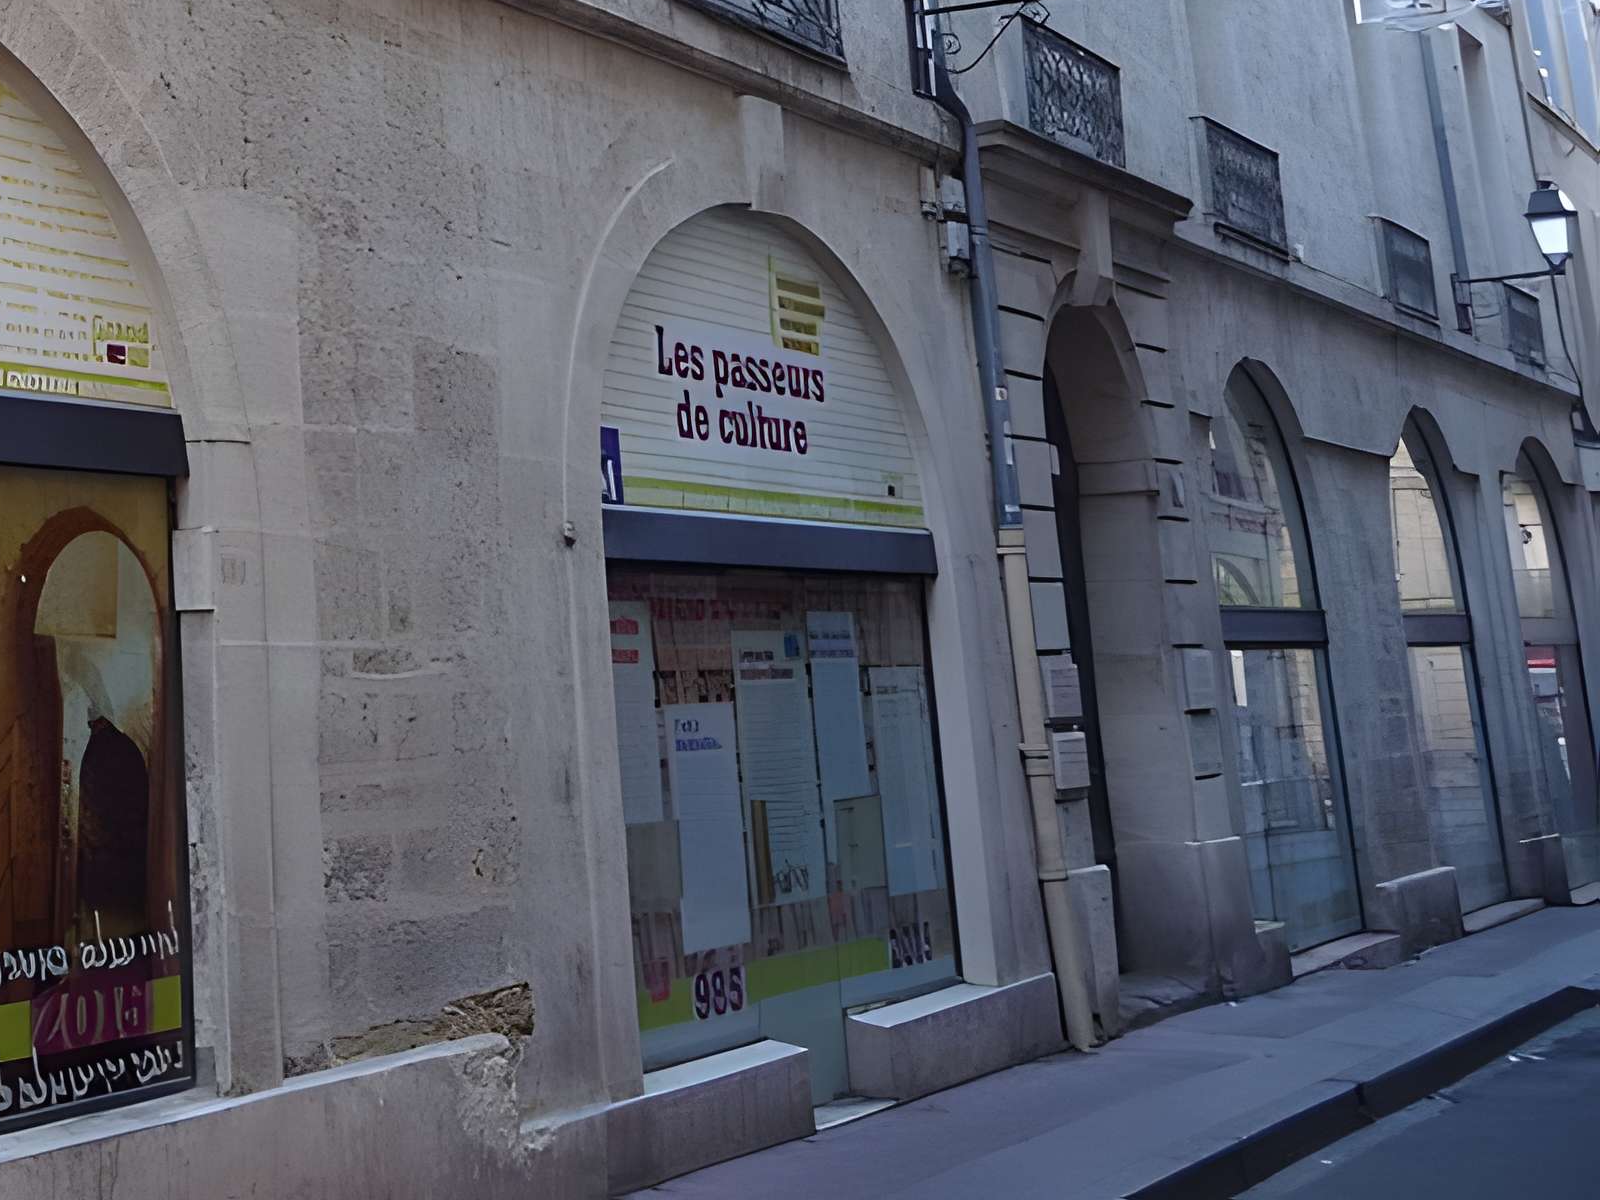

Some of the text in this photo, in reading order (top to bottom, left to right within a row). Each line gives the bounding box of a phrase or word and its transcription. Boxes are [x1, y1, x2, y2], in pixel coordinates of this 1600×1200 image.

[654, 324, 826, 403] Les passeurs
[676, 389, 809, 455] de culture
[694, 966, 744, 1020] 985
